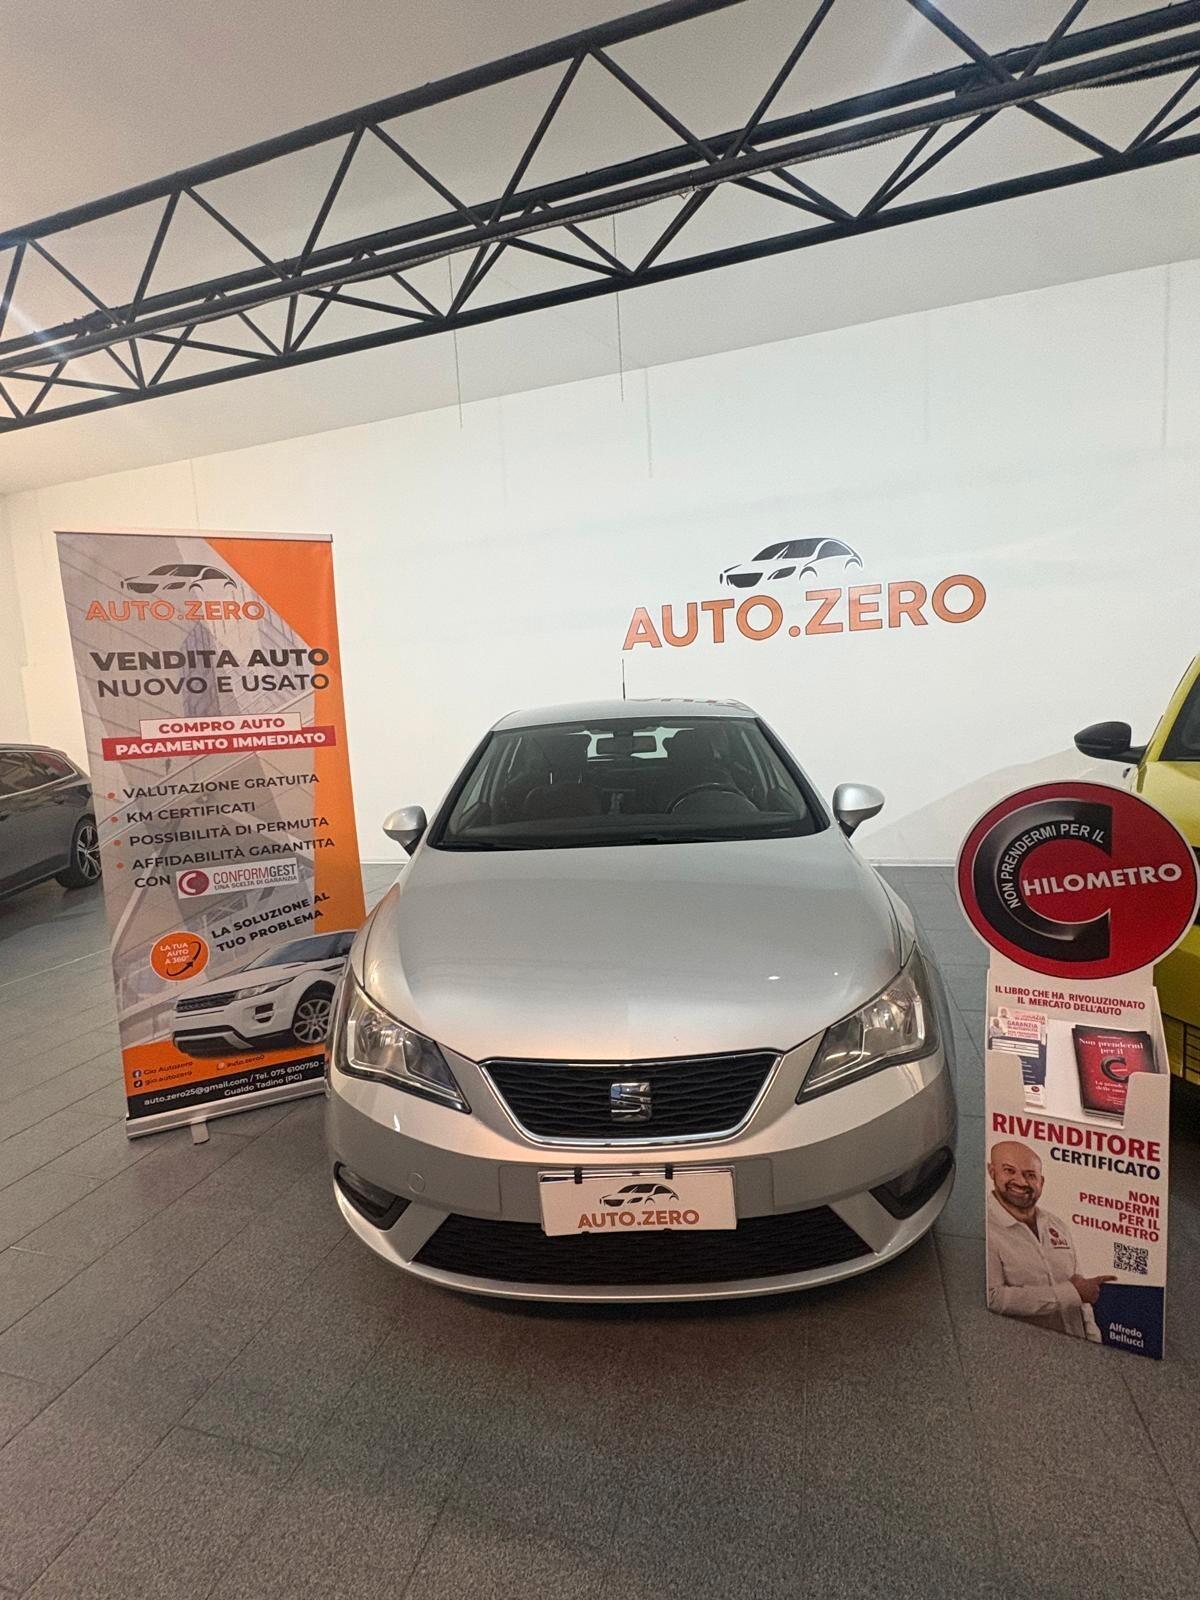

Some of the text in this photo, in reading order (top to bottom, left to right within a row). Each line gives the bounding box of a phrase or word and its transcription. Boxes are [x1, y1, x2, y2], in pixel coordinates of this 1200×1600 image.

[85, 600, 265, 621] AUTO.ZERO
[622, 574, 987, 651] AUTO.ZERO
[90, 648, 329, 672] VENDITA AUTO
[97, 673, 329, 698] NUOVO E USATO
[159, 717, 285, 734] COMPRO AUTO
[115, 732, 326, 756] PAGAMENTO IMMEDIATO
[123, 773, 320, 800] VALUTAZIONE GRATUITA
[127, 802, 256, 824] KM CERTIFICATI
[129, 816, 329, 847] POSSIBILITÀ DI PERMUTA
[132, 837, 335, 871] AFFIDABILITÀ GARANTITA
[1001, 823, 1104, 910] NON PRENDERMI PER IL
[134, 863, 296, 889] CON CONFORMGEST
[214, 882, 231, 891] UNA
[231, 880, 255, 889] SCELTA
[211, 892, 331, 940] LA SOLUZIONE AL
[216, 909, 324, 953] TUO PROBLEMA
[166, 949, 189, 958] AUTO
[995, 985, 1146, 1010] IL LIBRO CHE HA RIVOLUZIONATO
[1017, 996, 1122, 1016] IL MERCATO DELL'AUTO
[143, 1077, 248, 1106] auto.zero25@gmail.com
[254, 1072, 270, 1082] Tel.
[270, 1068, 286, 1077] 075
[287, 1061, 320, 1074] 6100750
[223, 1073, 303, 1097] Gualdo Tadino (PG)
[992, 1112, 1161, 1163] RIVENDITORE
[1050, 1146, 1161, 1181] CERTIFICATO
[1079, 1191, 1160, 1219] PRENDERMI
[1128, 1190, 1160, 1207] NON
[577, 1209, 700, 1229] AUTO.ZERO
[1072, 1213, 1159, 1242] CHILOMETRO
[1118, 1212, 1161, 1231] PER IL
[1109, 1322, 1142, 1338] Alfredo
[1109, 1331, 1144, 1349] Bellucci
